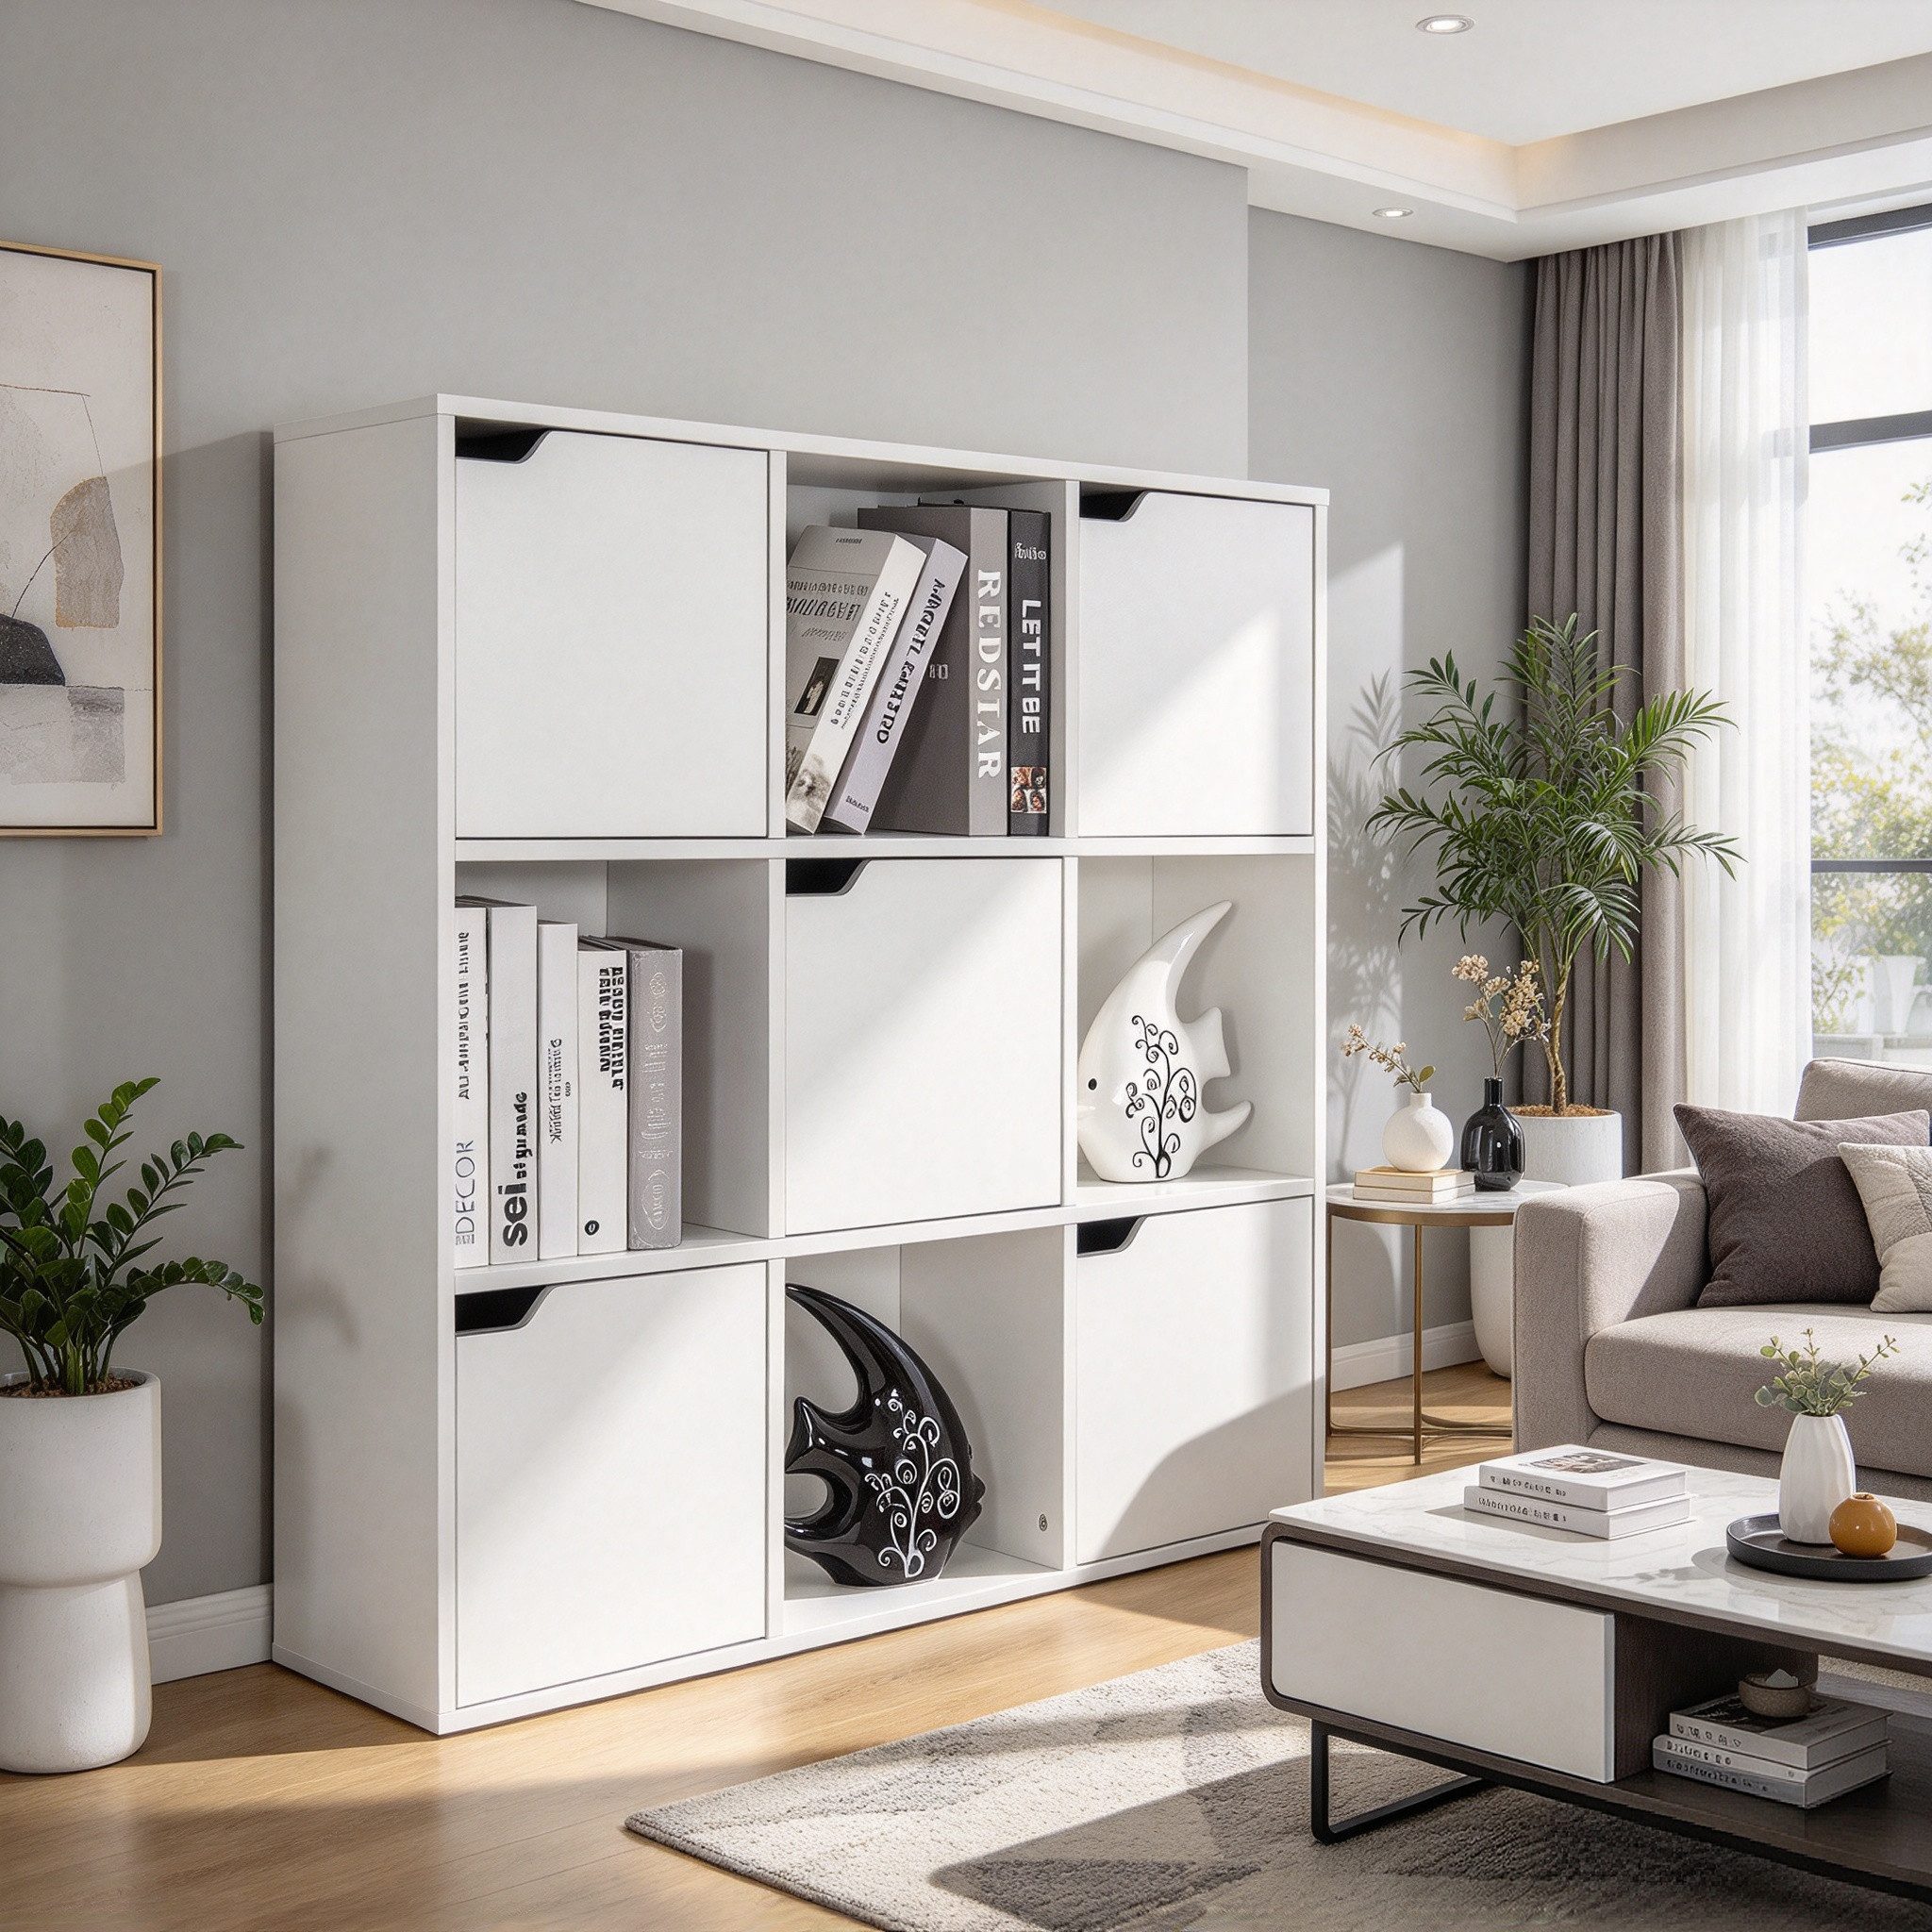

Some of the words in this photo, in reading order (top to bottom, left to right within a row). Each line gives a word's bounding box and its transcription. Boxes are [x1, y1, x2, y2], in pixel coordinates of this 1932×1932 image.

[1022, 599, 1041, 657] LET
[977, 569, 1002, 779] REDSTAR
[1022, 663, 1041, 691] IT
[1022, 697, 1041, 734] BE
[455, 1140, 475, 1234] DECOR
